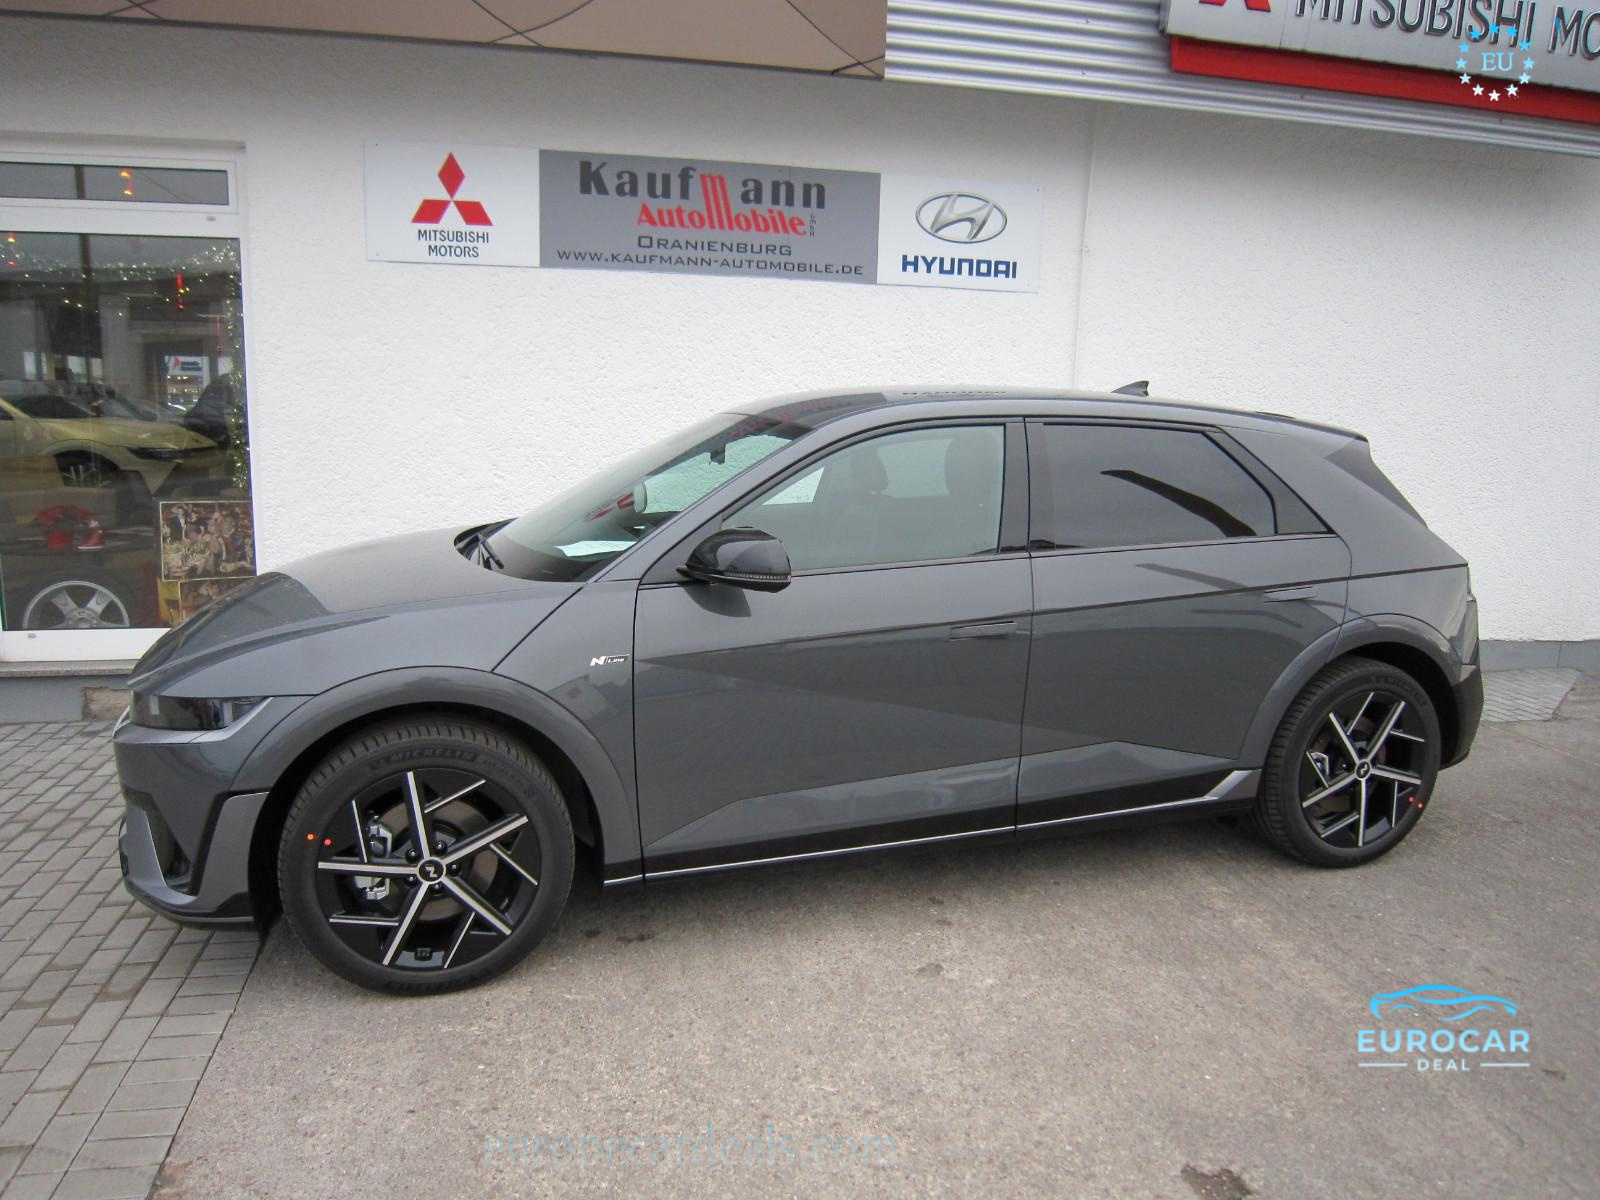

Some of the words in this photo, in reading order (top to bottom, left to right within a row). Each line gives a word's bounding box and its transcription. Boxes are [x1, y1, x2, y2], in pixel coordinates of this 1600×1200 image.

[417, 229, 490, 244] MITSUBISHI
[428, 245, 480, 258] MOTORS
[901, 254, 1018, 279] HYUNDAI
